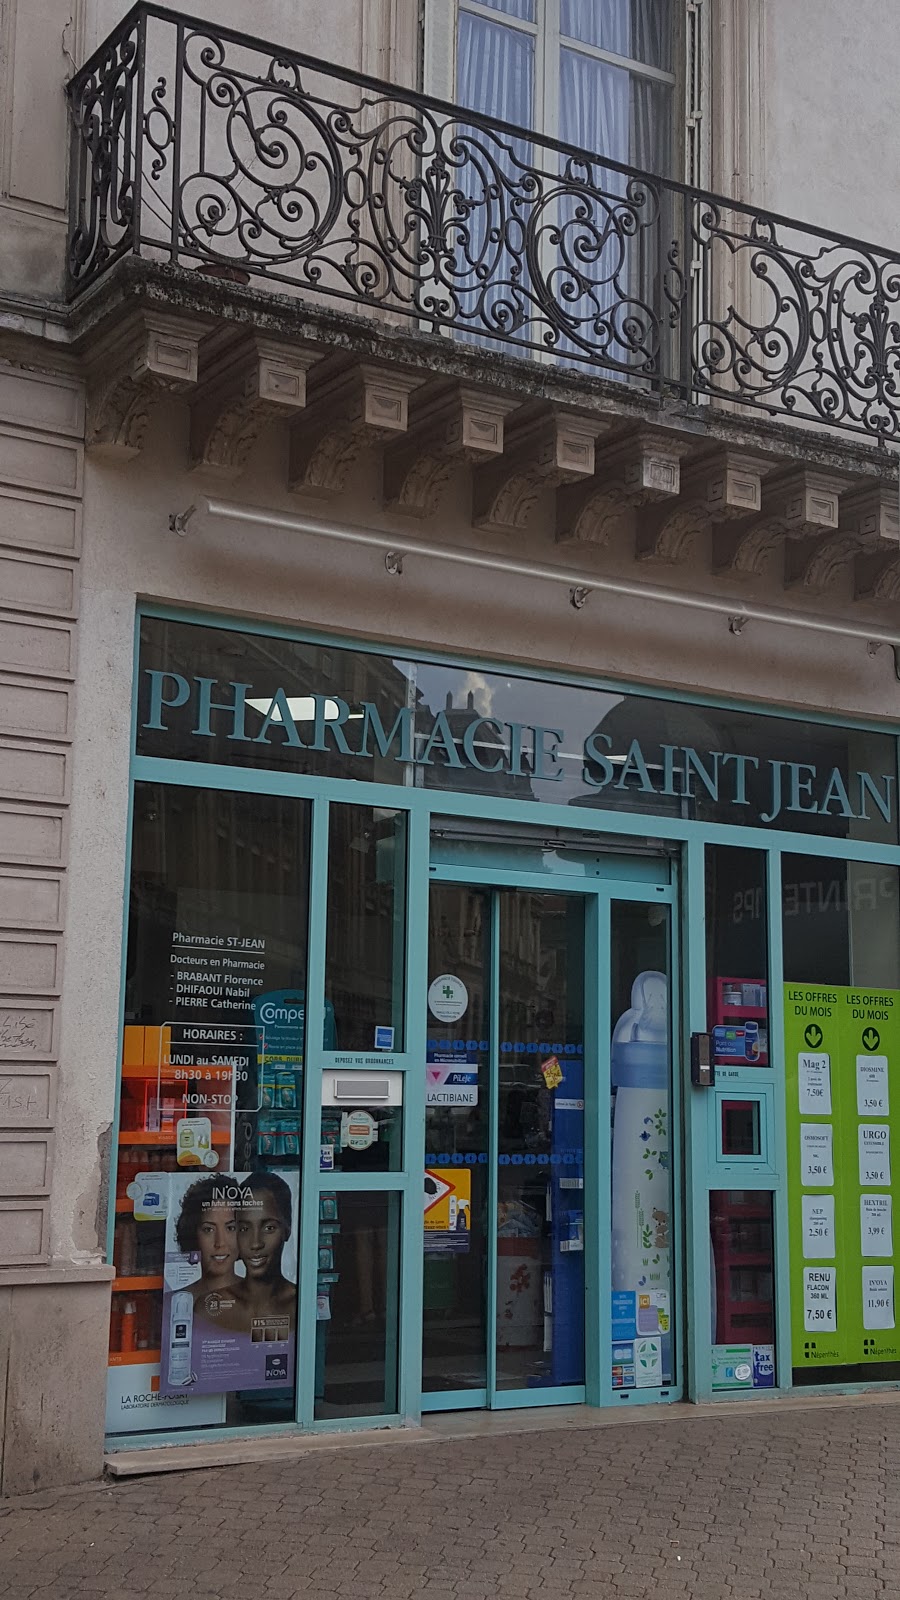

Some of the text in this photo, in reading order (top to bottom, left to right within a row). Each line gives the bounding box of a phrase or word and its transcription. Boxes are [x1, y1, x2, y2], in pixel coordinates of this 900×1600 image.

[142, 669, 894, 823] PHARMACIE SAINT JEAN
[172, 932, 265, 949] Pharmacie ST-JEAN
[170, 954, 208, 966] Docteurs
[222, 958, 265, 970] Pharmacie
[177, 971, 222, 983] BRABANT
[224, 974, 264, 986] Florence
[176, 984, 222, 996] DHIFAOUI
[225, 987, 250, 998] Nabil
[175, 996, 208, 1008] PIERRE
[210, 999, 256, 1011] Catherine
[788, 991, 837, 1004] LES OFFRES
[846, 994, 894, 1007] LES OFFRES
[794, 1005, 832, 1017] DU MOIS
[852, 1009, 889, 1021] DU MOIS
[183, 1028, 237, 1041] HORAIRES
[163, 1054, 249, 1067] LUNDI au SAMEDI
[802, 1058, 827, 1071] Mag 2
[174, 1069, 202, 1080] 8h30
[205, 1069, 212, 1080] à
[215, 1070, 248, 1081] 19h30
[182, 1093, 239, 1105] NON-STOP
[427, 1093, 474, 1102] LACTIBIANE
[864, 1099, 883, 1108] 3,50 €
[863, 1130, 887, 1139] URGO
[807, 1165, 827, 1175] 3,50 €
[865, 1171, 884, 1180] 3,50 €
[809, 1227, 829, 1237] 2,50 €
[867, 1227, 885, 1236] 3,99 €
[808, 1273, 831, 1282] RENU
[885, 1298, 890, 1307] €
[807, 1309, 832, 1320] 7,50 €
[755, 1351, 771, 1362] tax
[756, 1362, 774, 1372] free
[121, 1395, 132, 1404] LA
